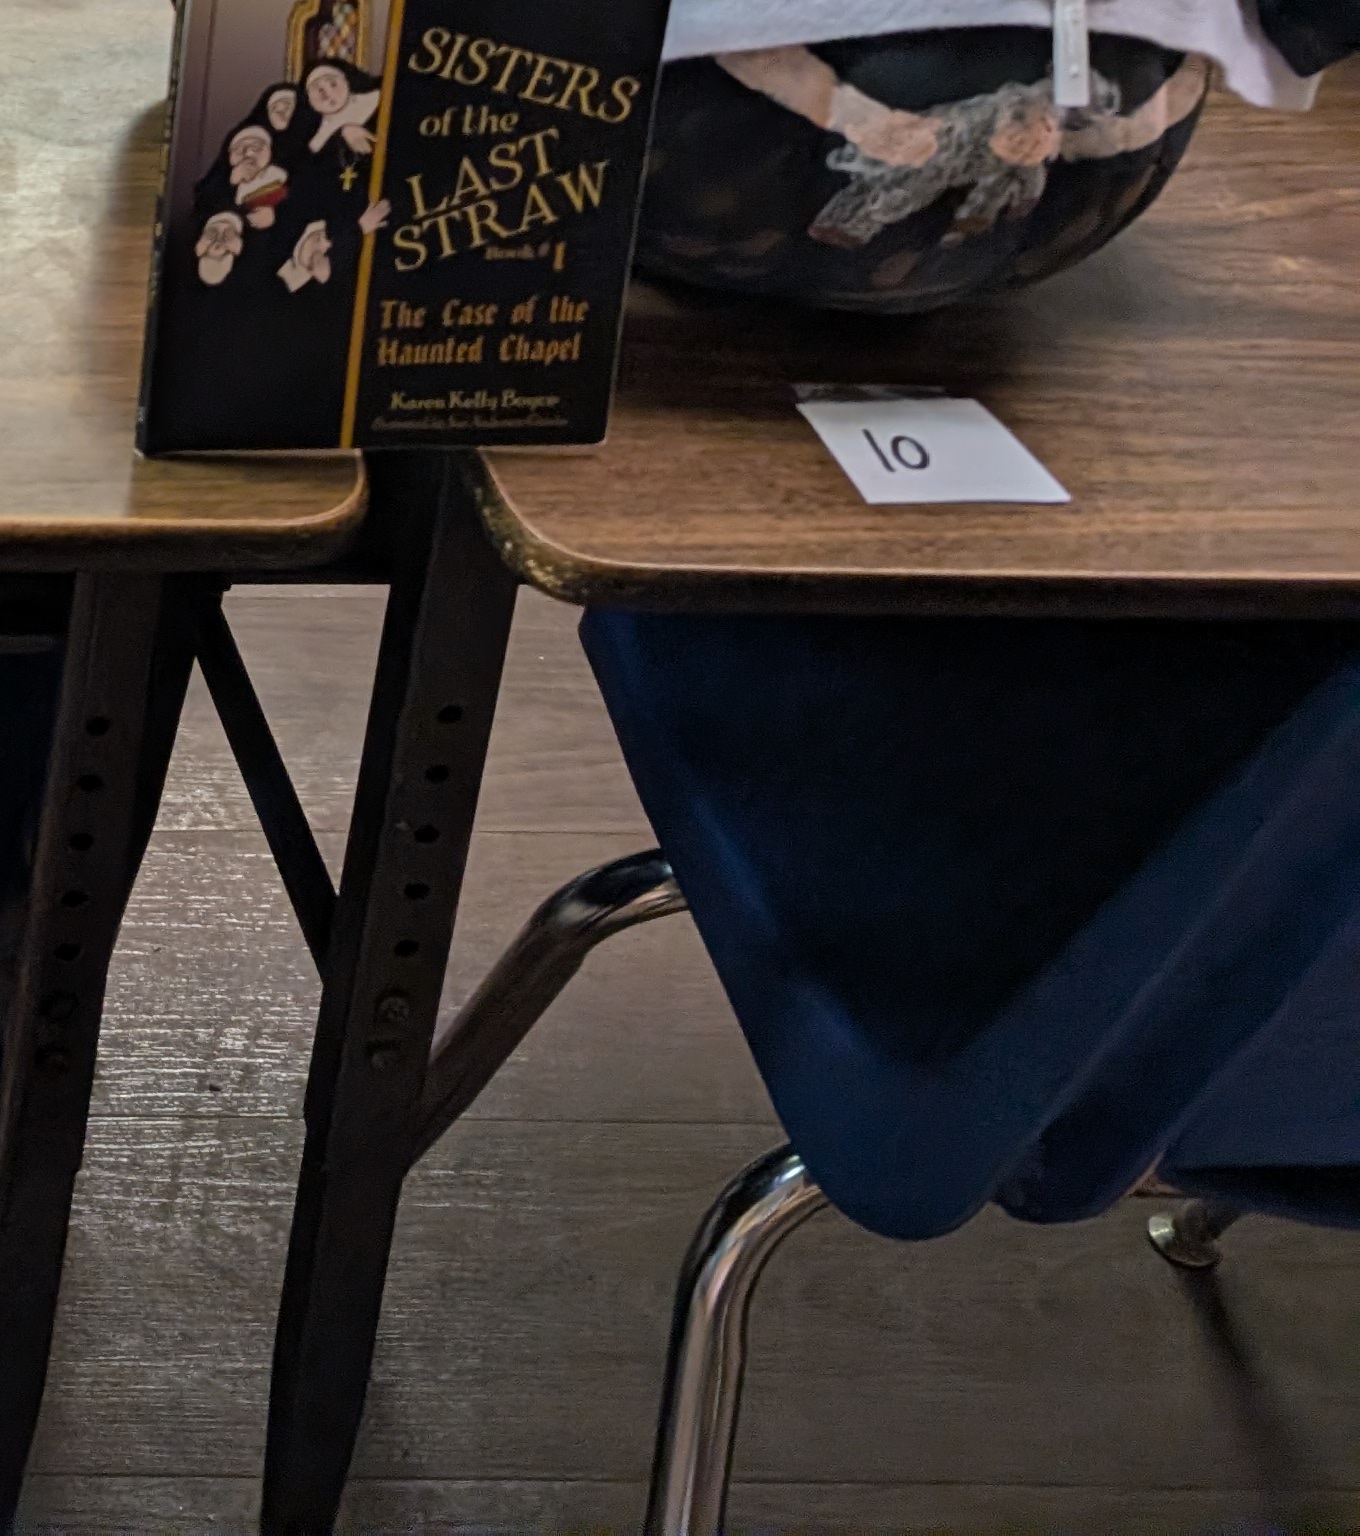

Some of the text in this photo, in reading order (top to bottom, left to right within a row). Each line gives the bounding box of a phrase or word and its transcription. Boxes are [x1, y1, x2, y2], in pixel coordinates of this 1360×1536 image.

[407, 26, 643, 124] SISTERS
[419, 104, 520, 137] of the
[406, 126, 561, 220] LAST
[393, 158, 611, 273] STRAW
[381, 293, 590, 330] The Case of the
[377, 330, 582, 368] Haunted Chapel
[862, 427, 930, 474] 10
